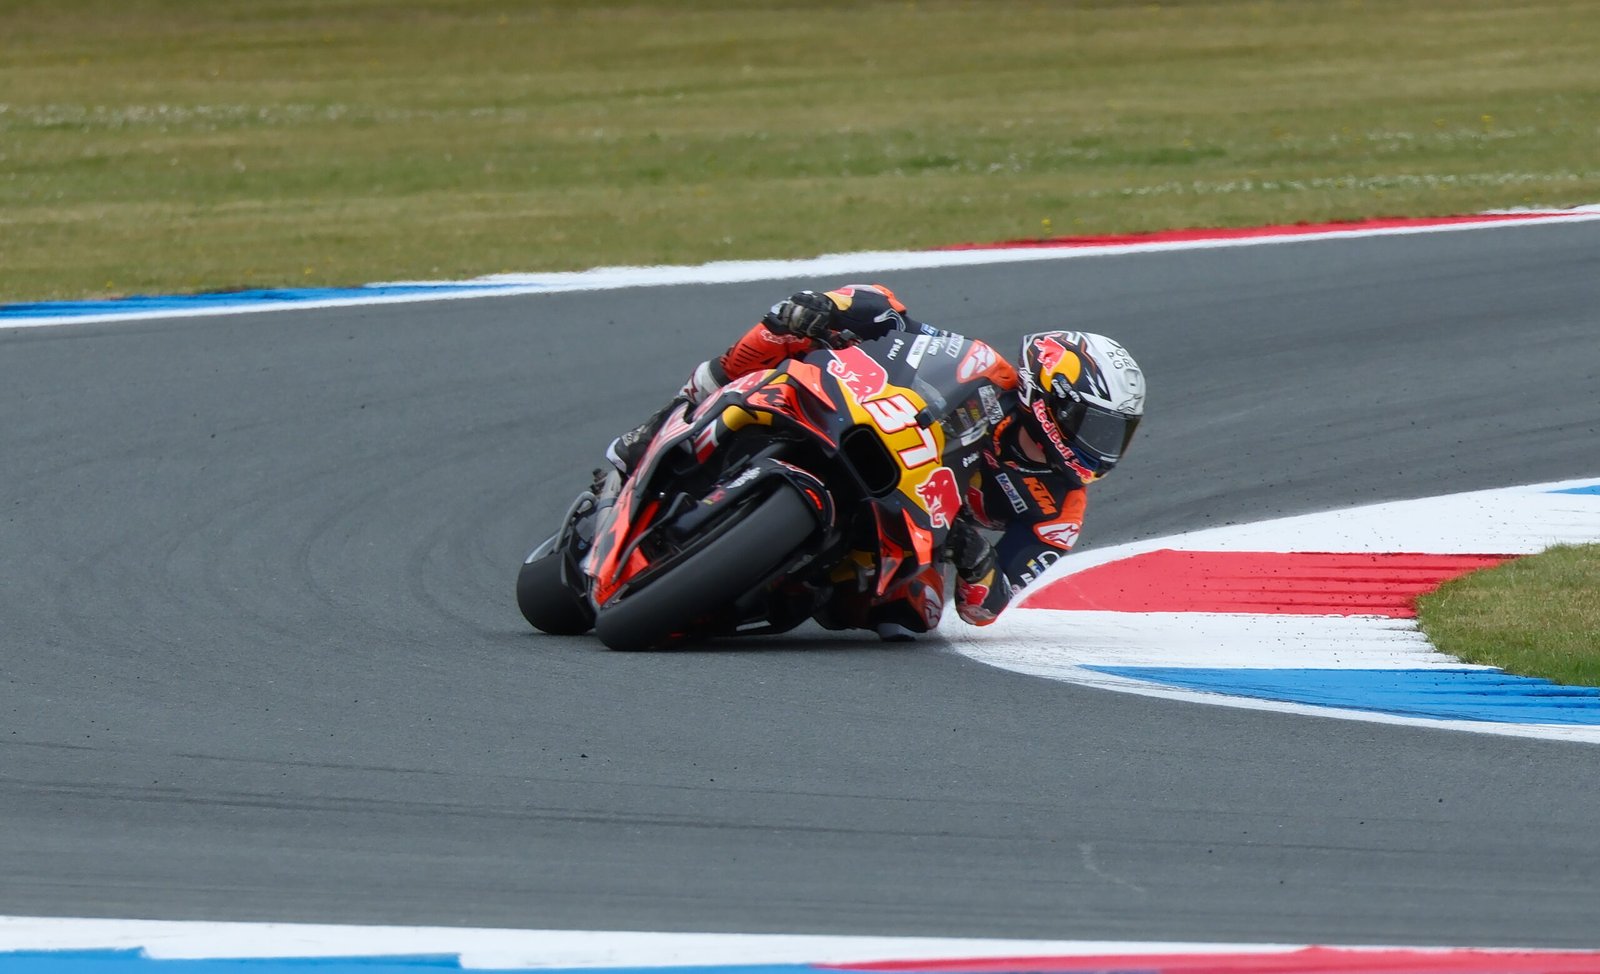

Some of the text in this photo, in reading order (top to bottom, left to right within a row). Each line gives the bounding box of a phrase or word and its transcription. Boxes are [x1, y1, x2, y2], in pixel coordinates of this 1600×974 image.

[861, 394, 940, 470] 37
[1031, 399, 1054, 433] Red
[1048, 427, 1075, 460] Bull
[998, 474, 1021, 504] Mobil
[1023, 477, 1057, 515] KTM
